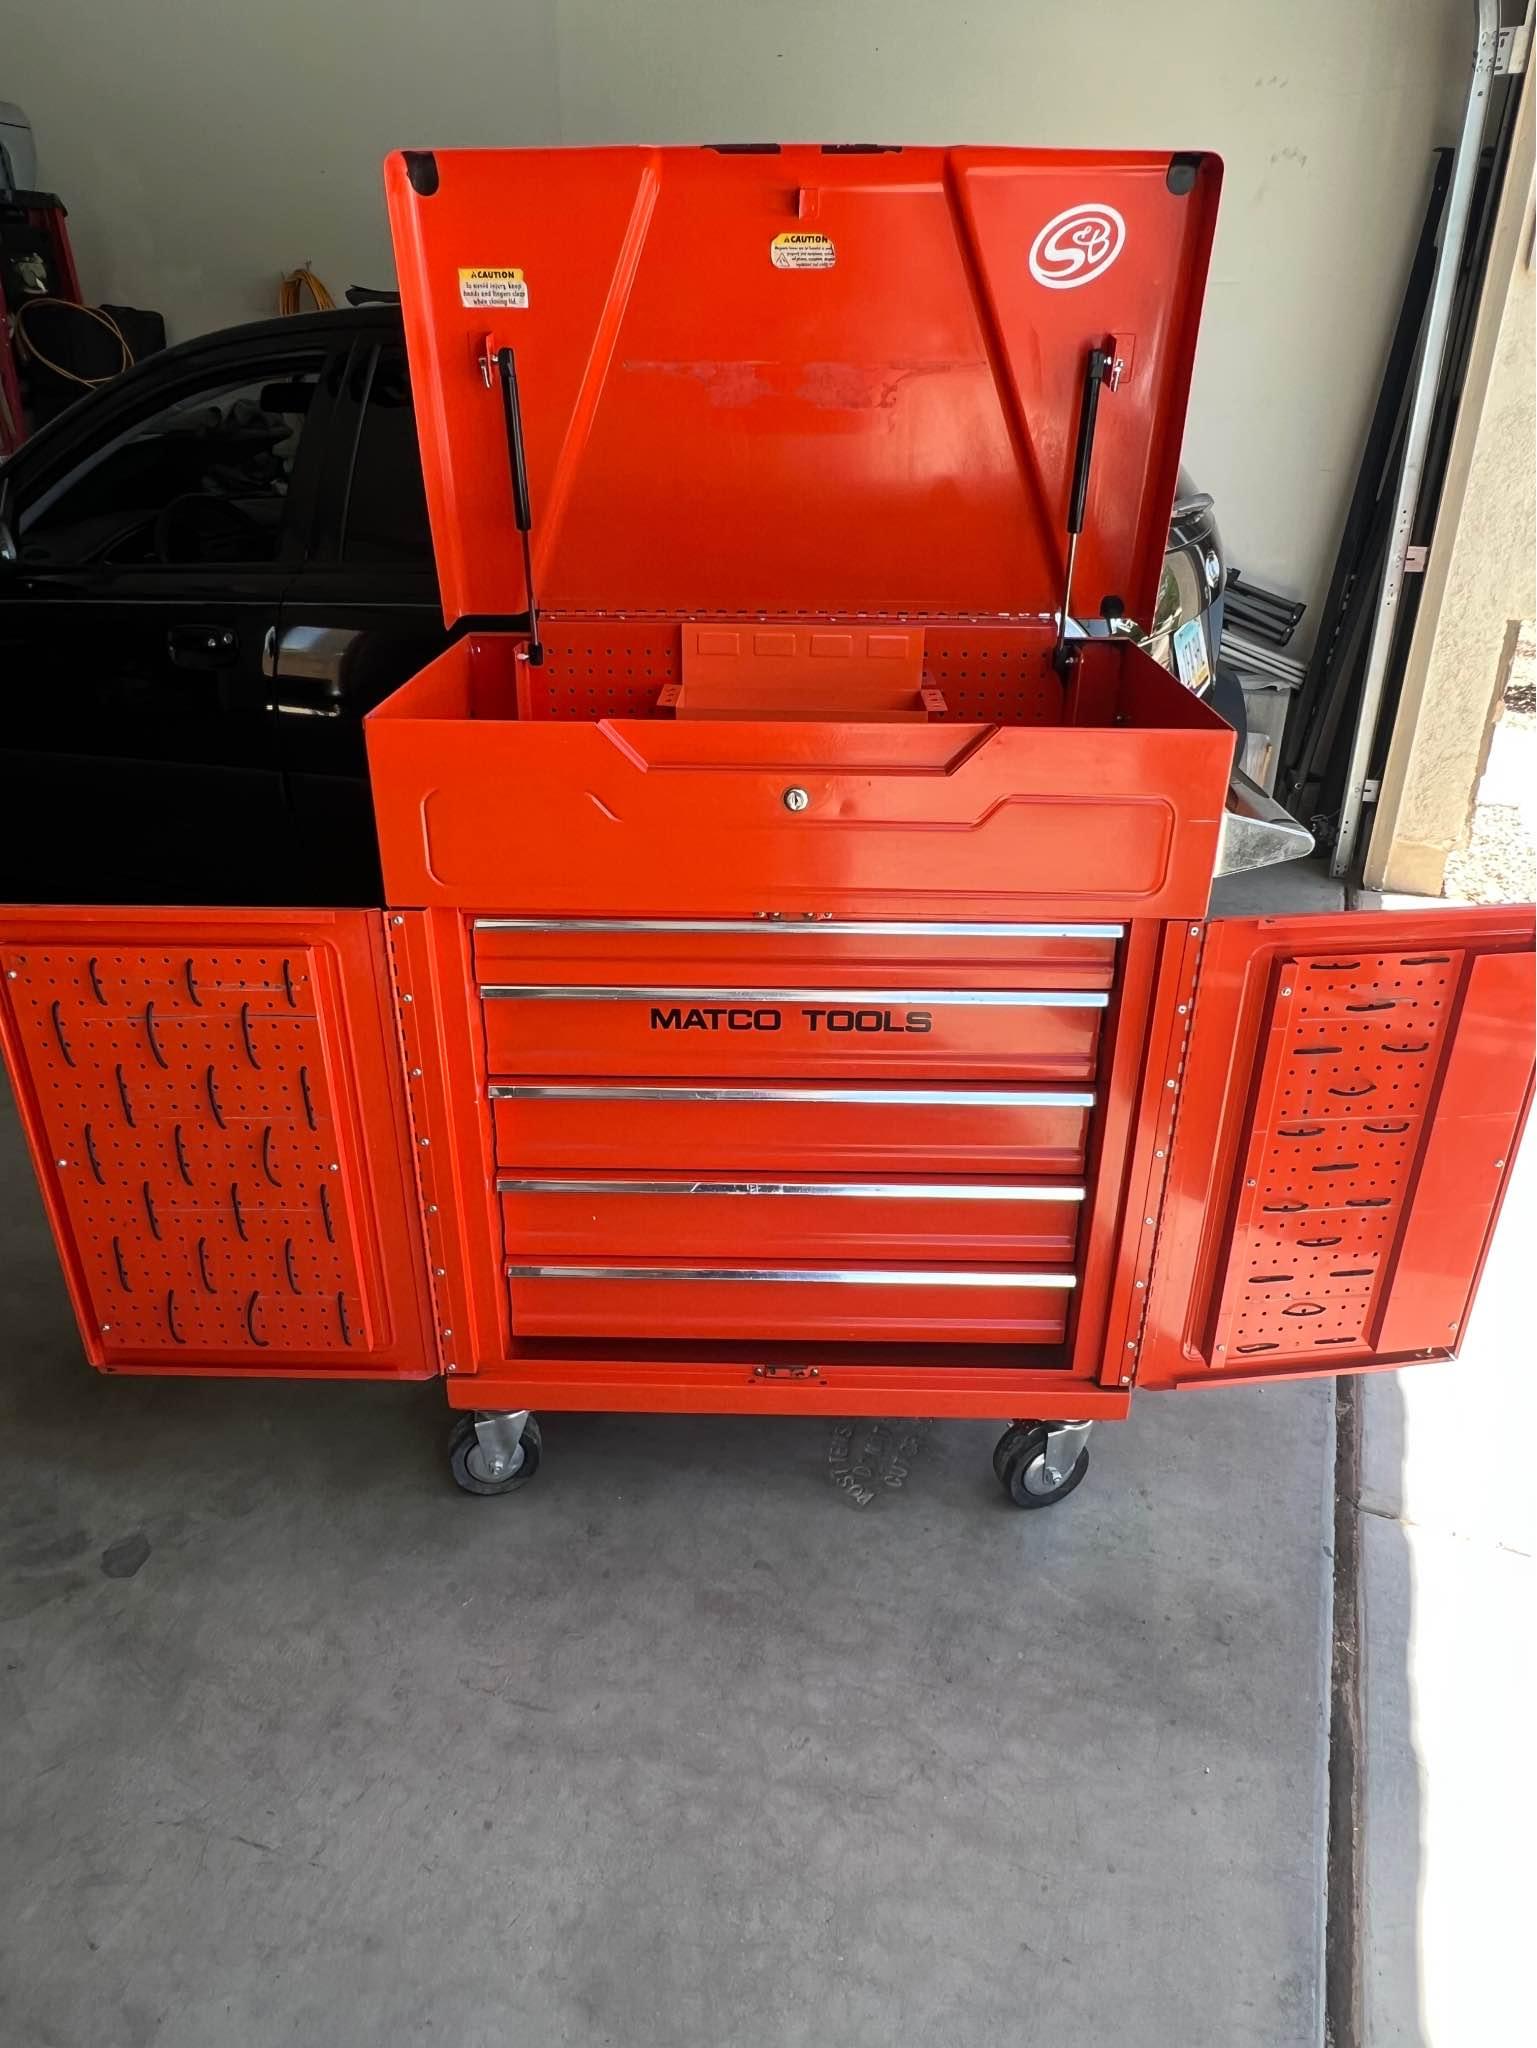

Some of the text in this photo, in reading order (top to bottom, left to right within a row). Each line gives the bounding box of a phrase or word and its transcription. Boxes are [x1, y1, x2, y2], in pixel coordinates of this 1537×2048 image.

[791, 235, 828, 243] CAUTION
[477, 271, 515, 279] CAUTION
[650, 1008, 932, 1032] MATCO TOOLS
